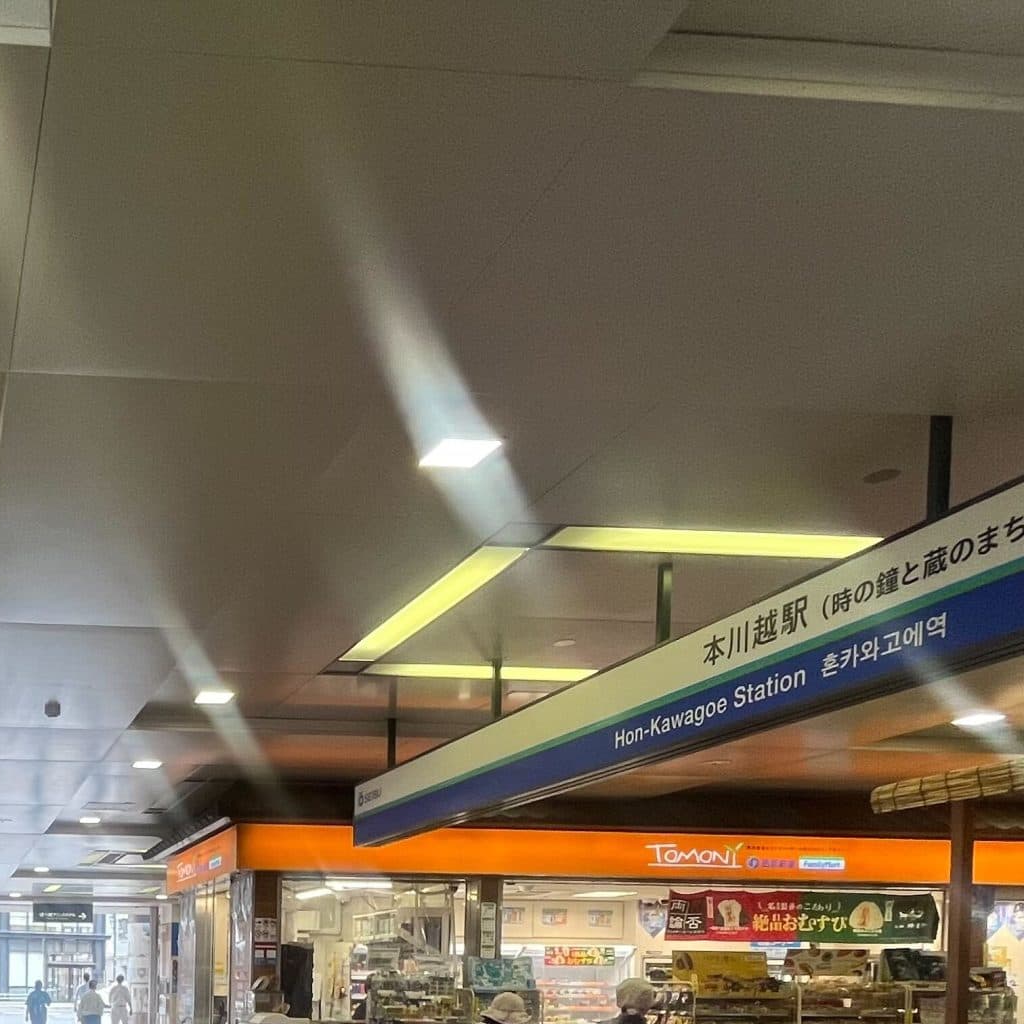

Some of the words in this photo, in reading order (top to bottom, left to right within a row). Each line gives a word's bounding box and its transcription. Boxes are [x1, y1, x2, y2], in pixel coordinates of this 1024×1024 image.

[703, 595, 808, 666] 本川越駅
[820, 611, 948, 679] 혼카와고에역
[614, 695, 727, 750] Hon-Kawagoe
[733, 667, 807, 709] Station
[752, 913, 849, 932] 絶品おむすび
